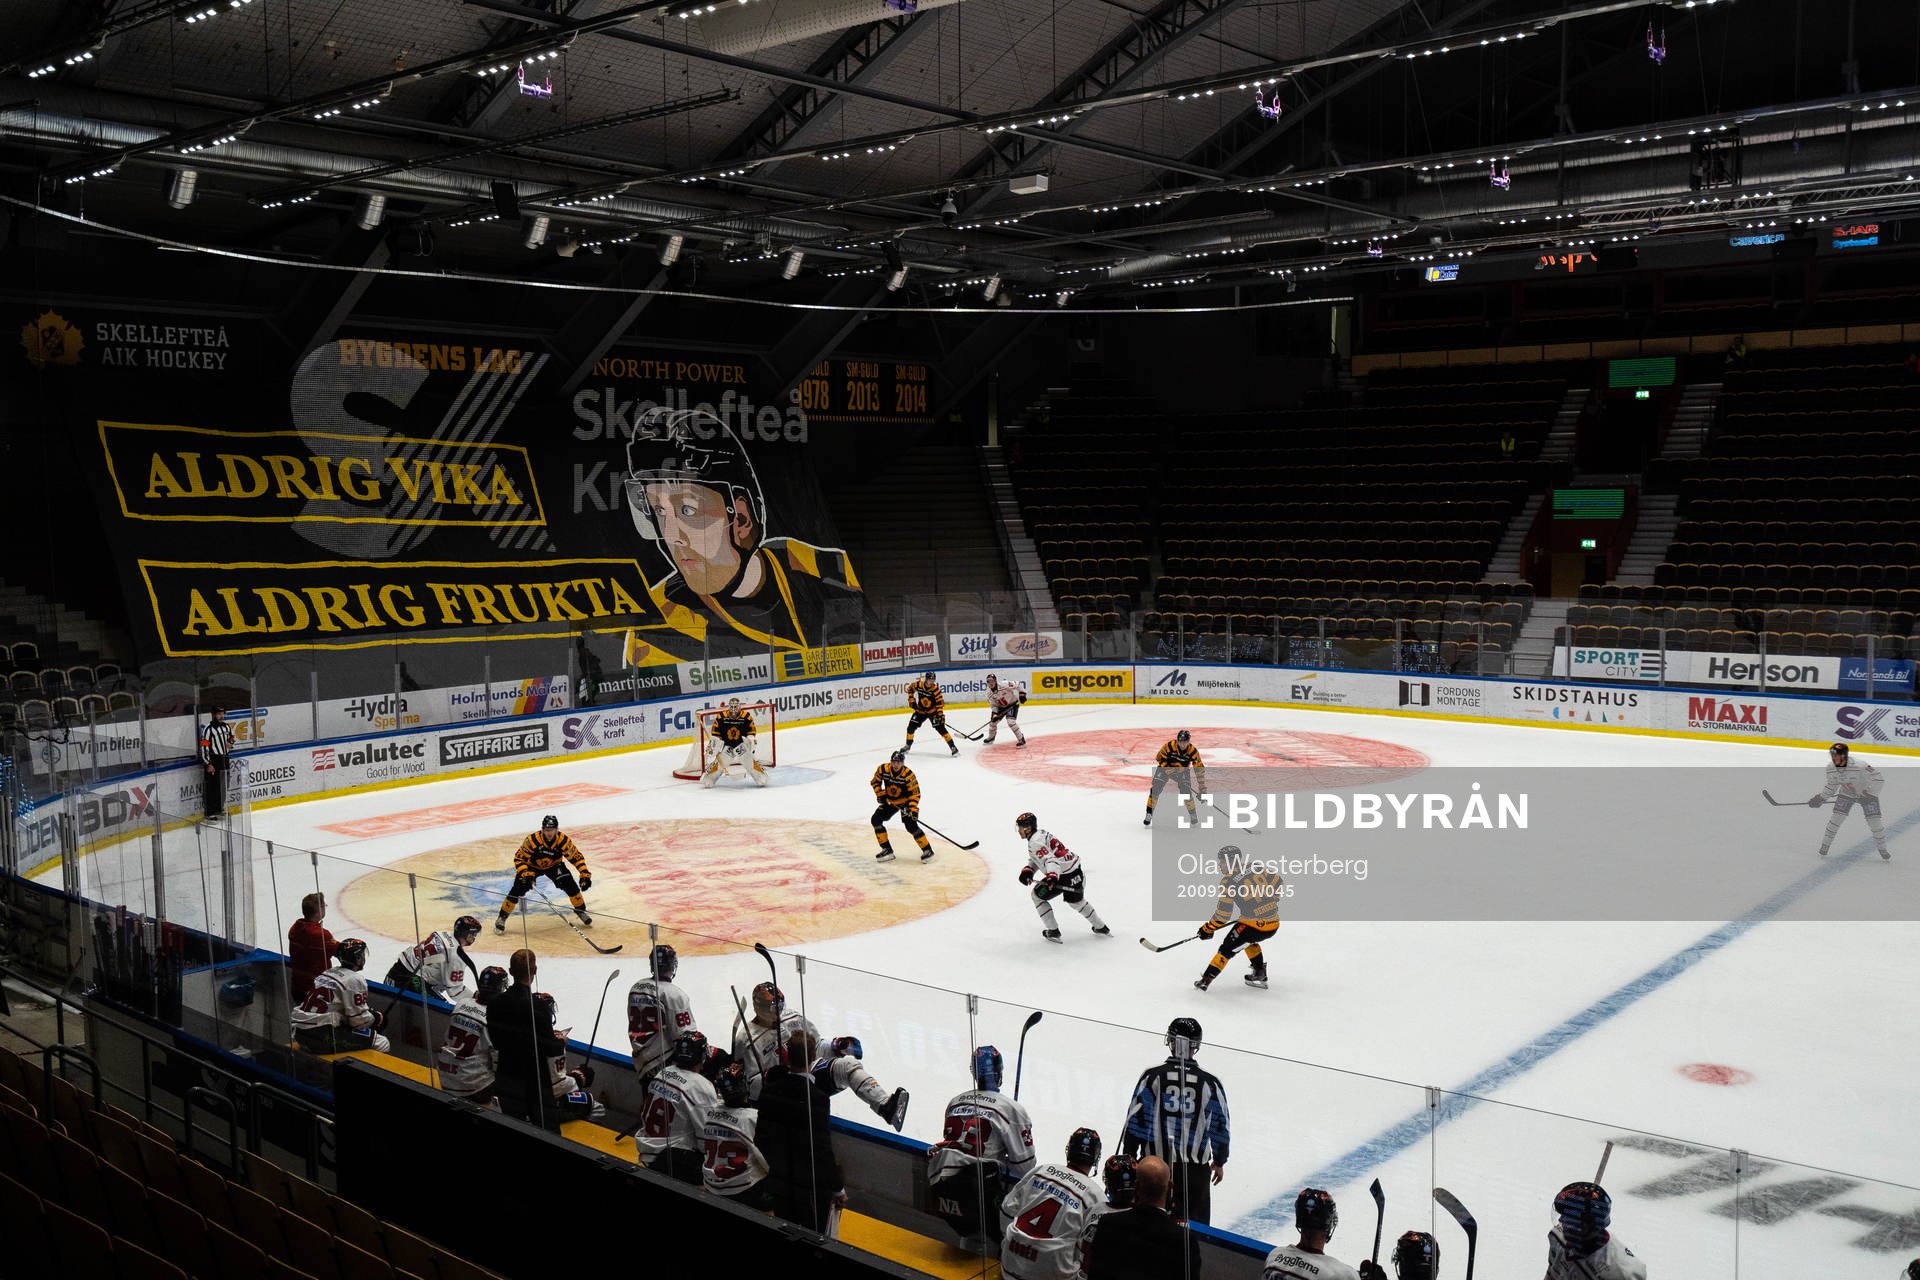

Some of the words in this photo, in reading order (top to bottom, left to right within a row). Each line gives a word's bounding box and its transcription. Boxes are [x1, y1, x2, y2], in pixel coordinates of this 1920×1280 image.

[96, 322, 230, 348] SKELLEFTEÅ
[102, 348, 138, 367] AIK
[147, 350, 227, 370] HOCKEY
[339, 339, 466, 372] BYGDENS
[593, 358, 670, 381] NORTH
[675, 362, 745, 384] POWER
[847, 381, 880, 412] 2013
[895, 384, 927, 414] 2014
[144, 451, 382, 502] ALDRIG
[384, 457, 524, 506] VIKA
[182, 583, 428, 638] ALDRIG
[426, 577, 647, 627] FRUKTA
[864, 641, 934, 661] HOLMSTRÖM
[958, 635, 998, 655] Stigs
[1574, 650, 1640, 666] SPORT
[1605, 666, 1638, 677] CITY
[598, 673, 674, 693] martinsons
[1042, 672, 1123, 692] engcon
[1197, 680, 1241, 689] Miljöteknik
[1437, 686, 1481, 698] FORDONS
[451, 687, 524, 705] Holmunds
[1291, 685, 1313, 700] EY
[1437, 697, 1481, 708] MONTAGE
[1513, 686, 1638, 707] SKIDSTAHUS
[374, 713, 420, 730] Spema
[603, 713, 645, 728] Skellefteå
[1688, 697, 1768, 726] MAXI
[603, 729, 625, 740] Kraft
[1702, 722, 1767, 733] STORMARKNAD
[338, 743, 425, 767] valutec
[445, 734, 521, 760] STAFFARE
[523, 731, 545, 748] AB
[367, 765, 389, 779] Good
[390, 764, 401, 775] for
[403, 761, 425, 774] Wood
[1164, 1085, 1196, 1115] 33
[1014, 1197, 1064, 1239] 4
